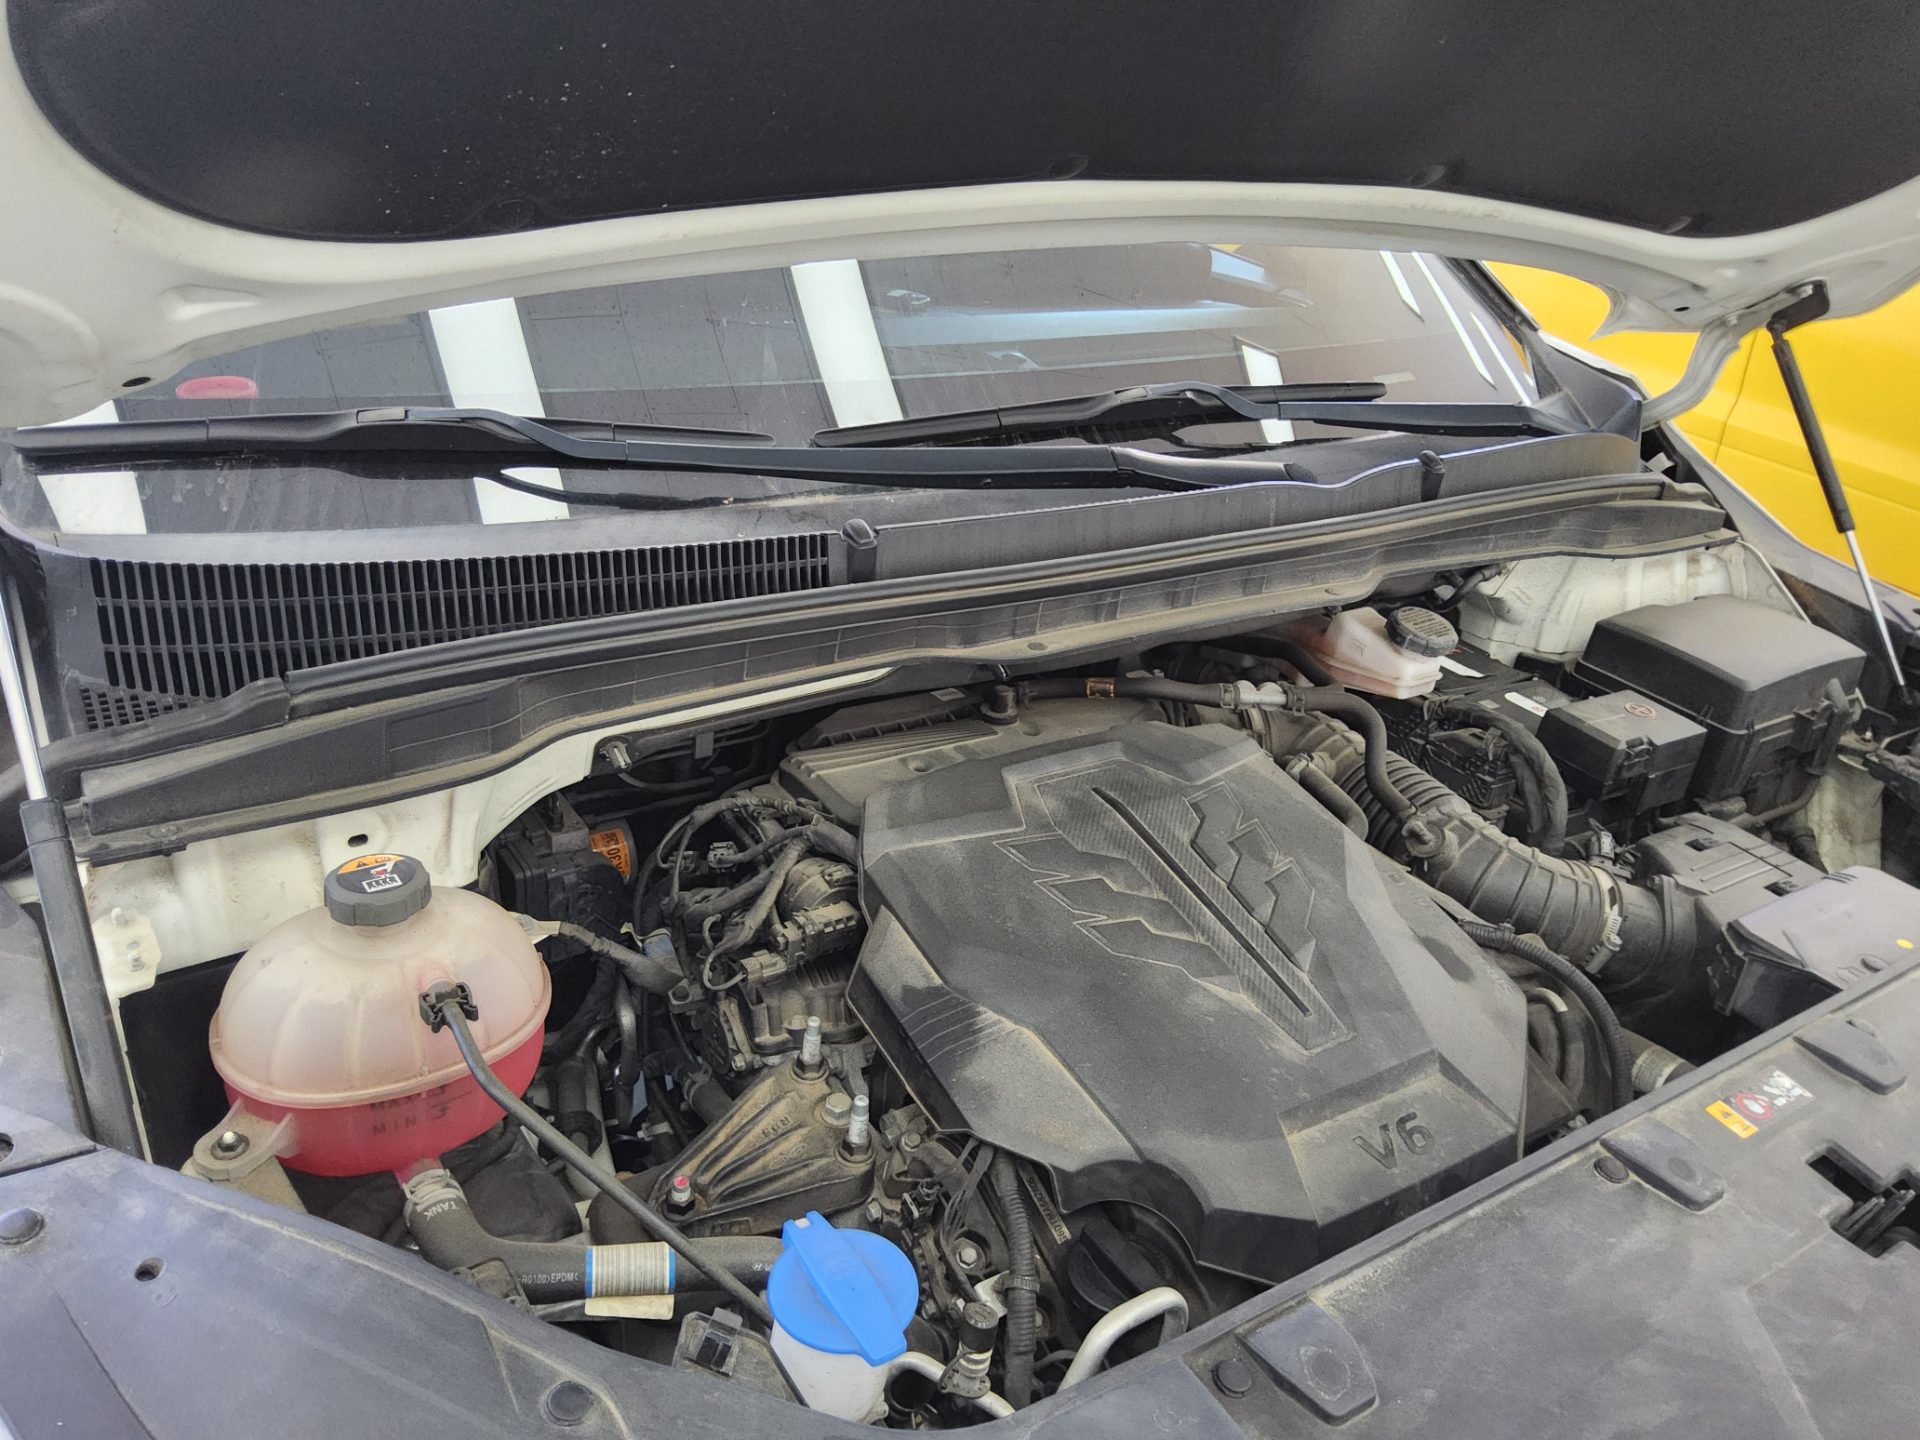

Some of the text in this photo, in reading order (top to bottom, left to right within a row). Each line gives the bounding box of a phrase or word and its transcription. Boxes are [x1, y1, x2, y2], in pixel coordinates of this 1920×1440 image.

[369, 1113, 417, 1135] MIN
[1352, 1112, 1435, 1169] V6
[423, 1201, 459, 1221] TANK
